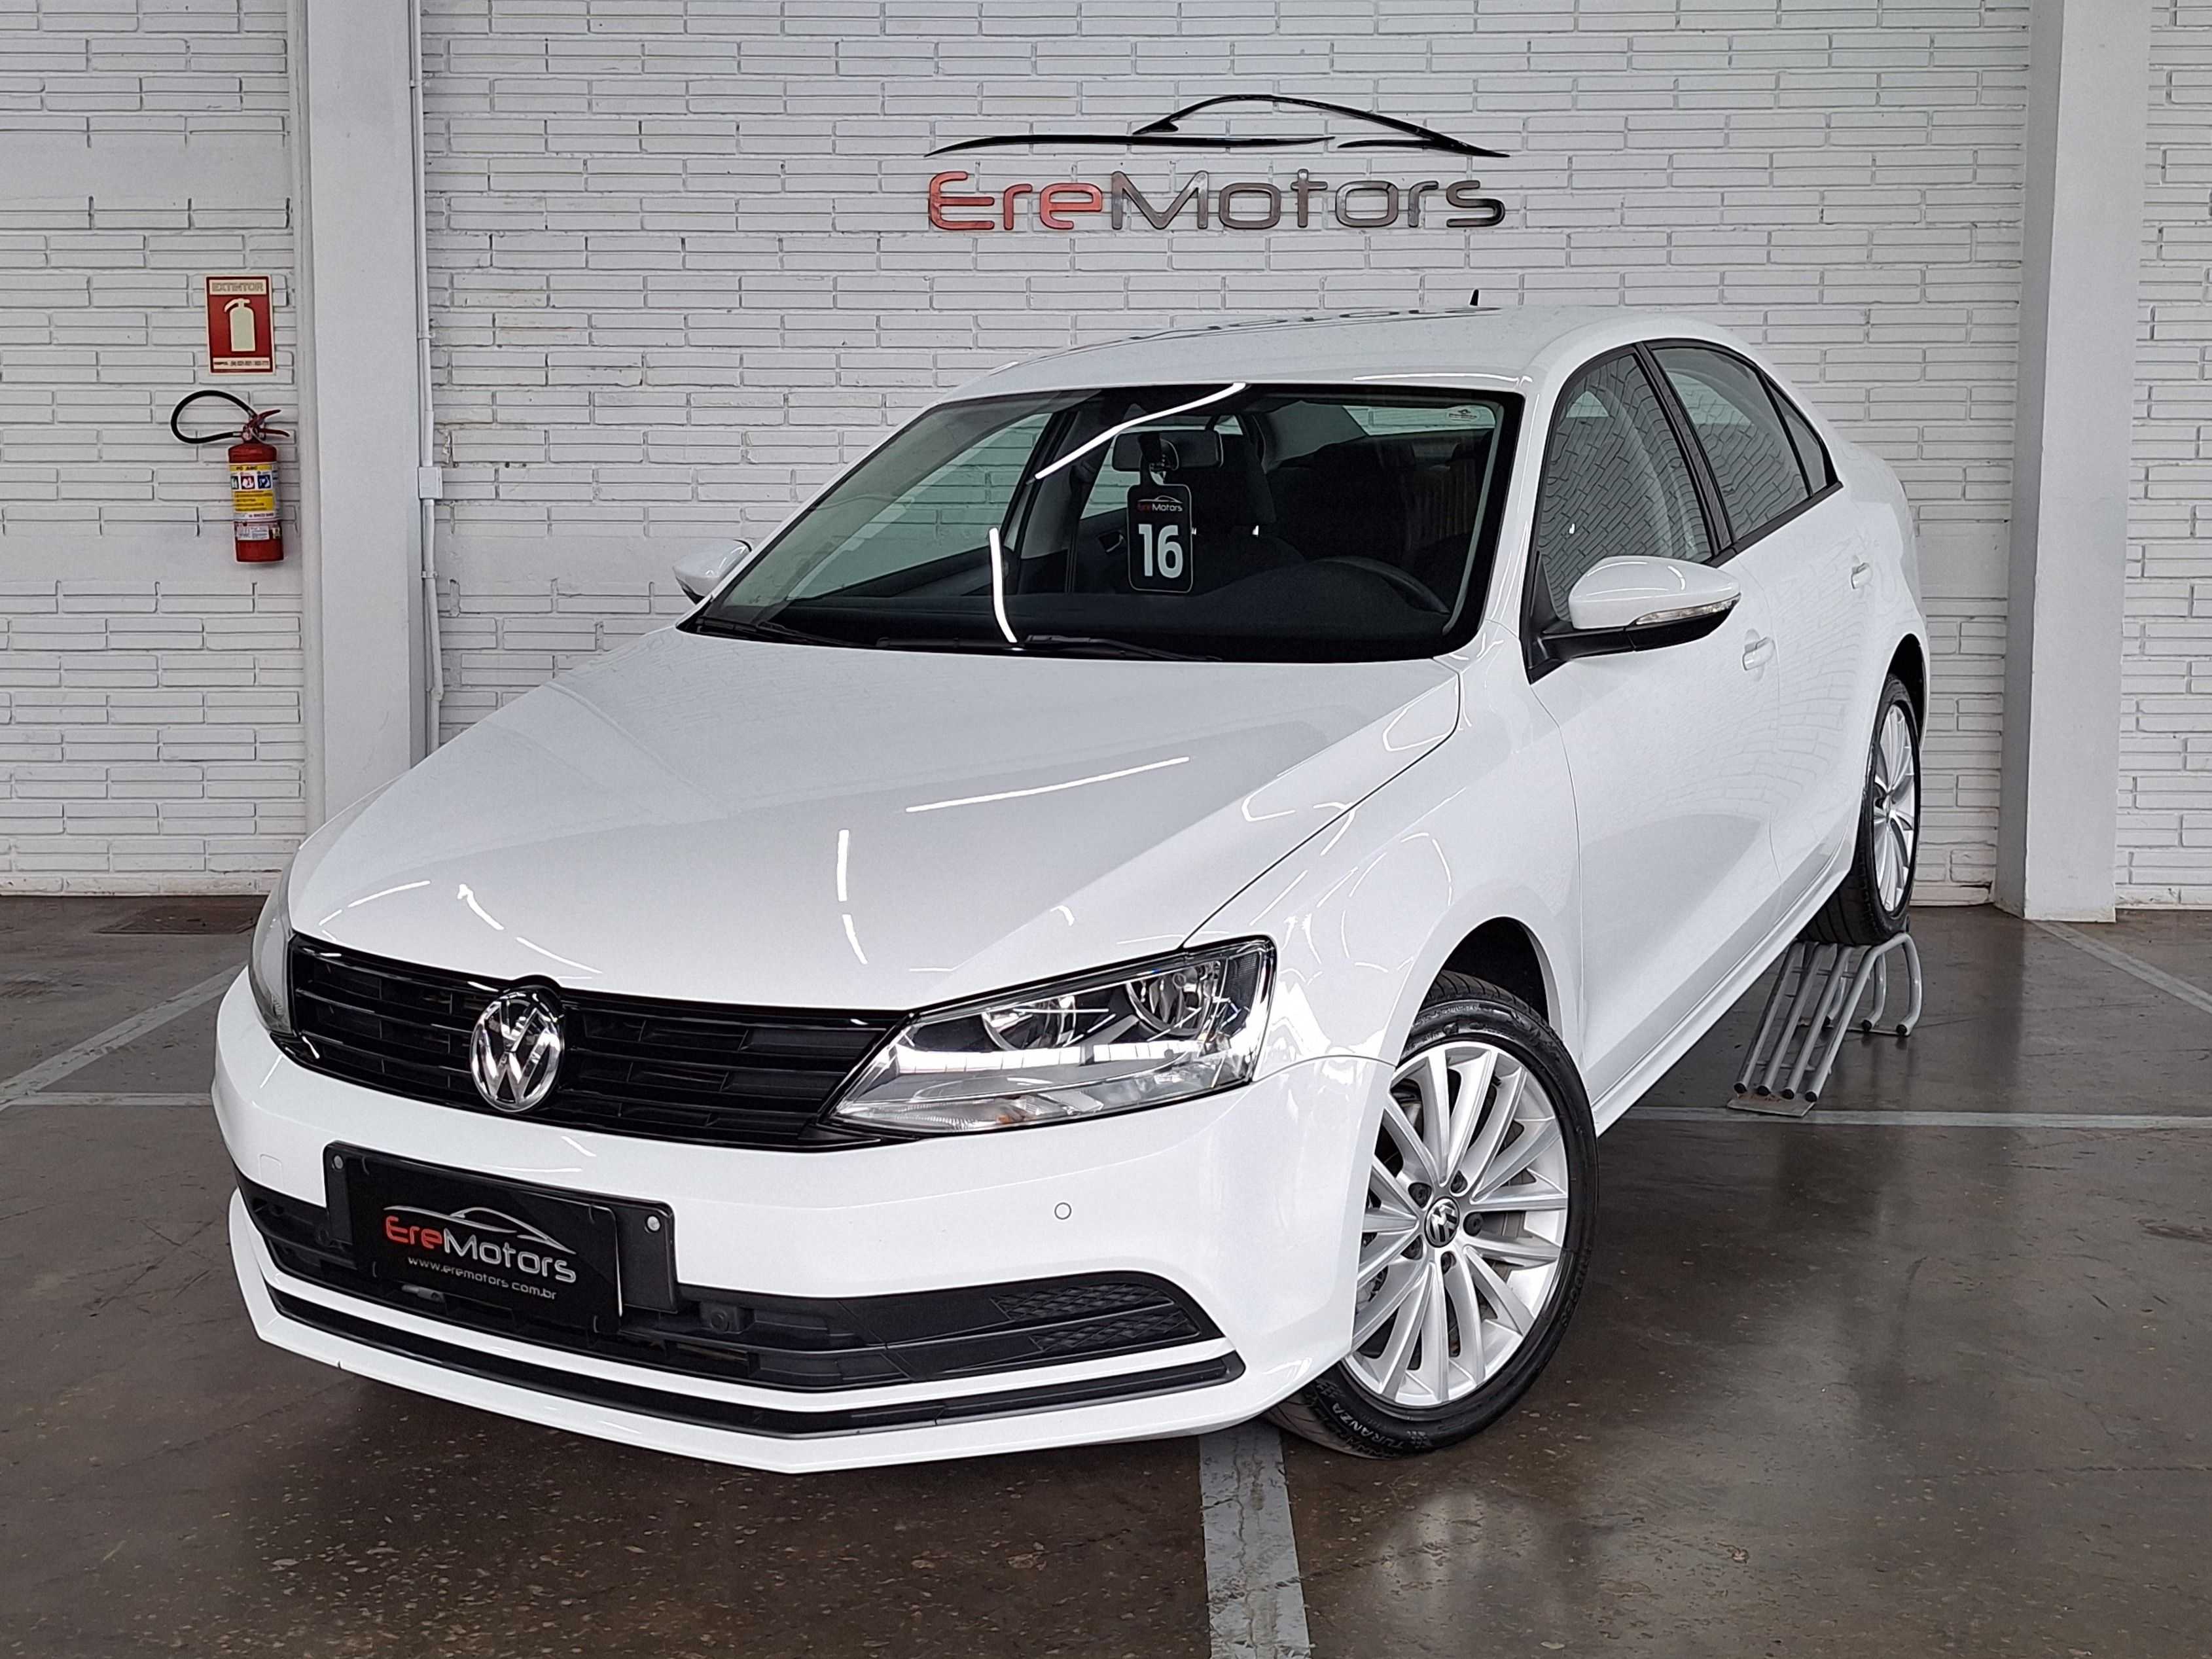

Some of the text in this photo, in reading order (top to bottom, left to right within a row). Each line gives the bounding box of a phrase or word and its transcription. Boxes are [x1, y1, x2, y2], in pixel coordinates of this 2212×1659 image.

[928, 169, 1506, 230] EreMotors
[211, 281, 264, 292] EXTINTOR
[1138, 524, 1183, 579] 16
[385, 1215, 577, 1283] EreMotors
[407, 1256, 558, 1300] www.eremotorscom.br
[1332, 1402, 1404, 1450] TURANZA
